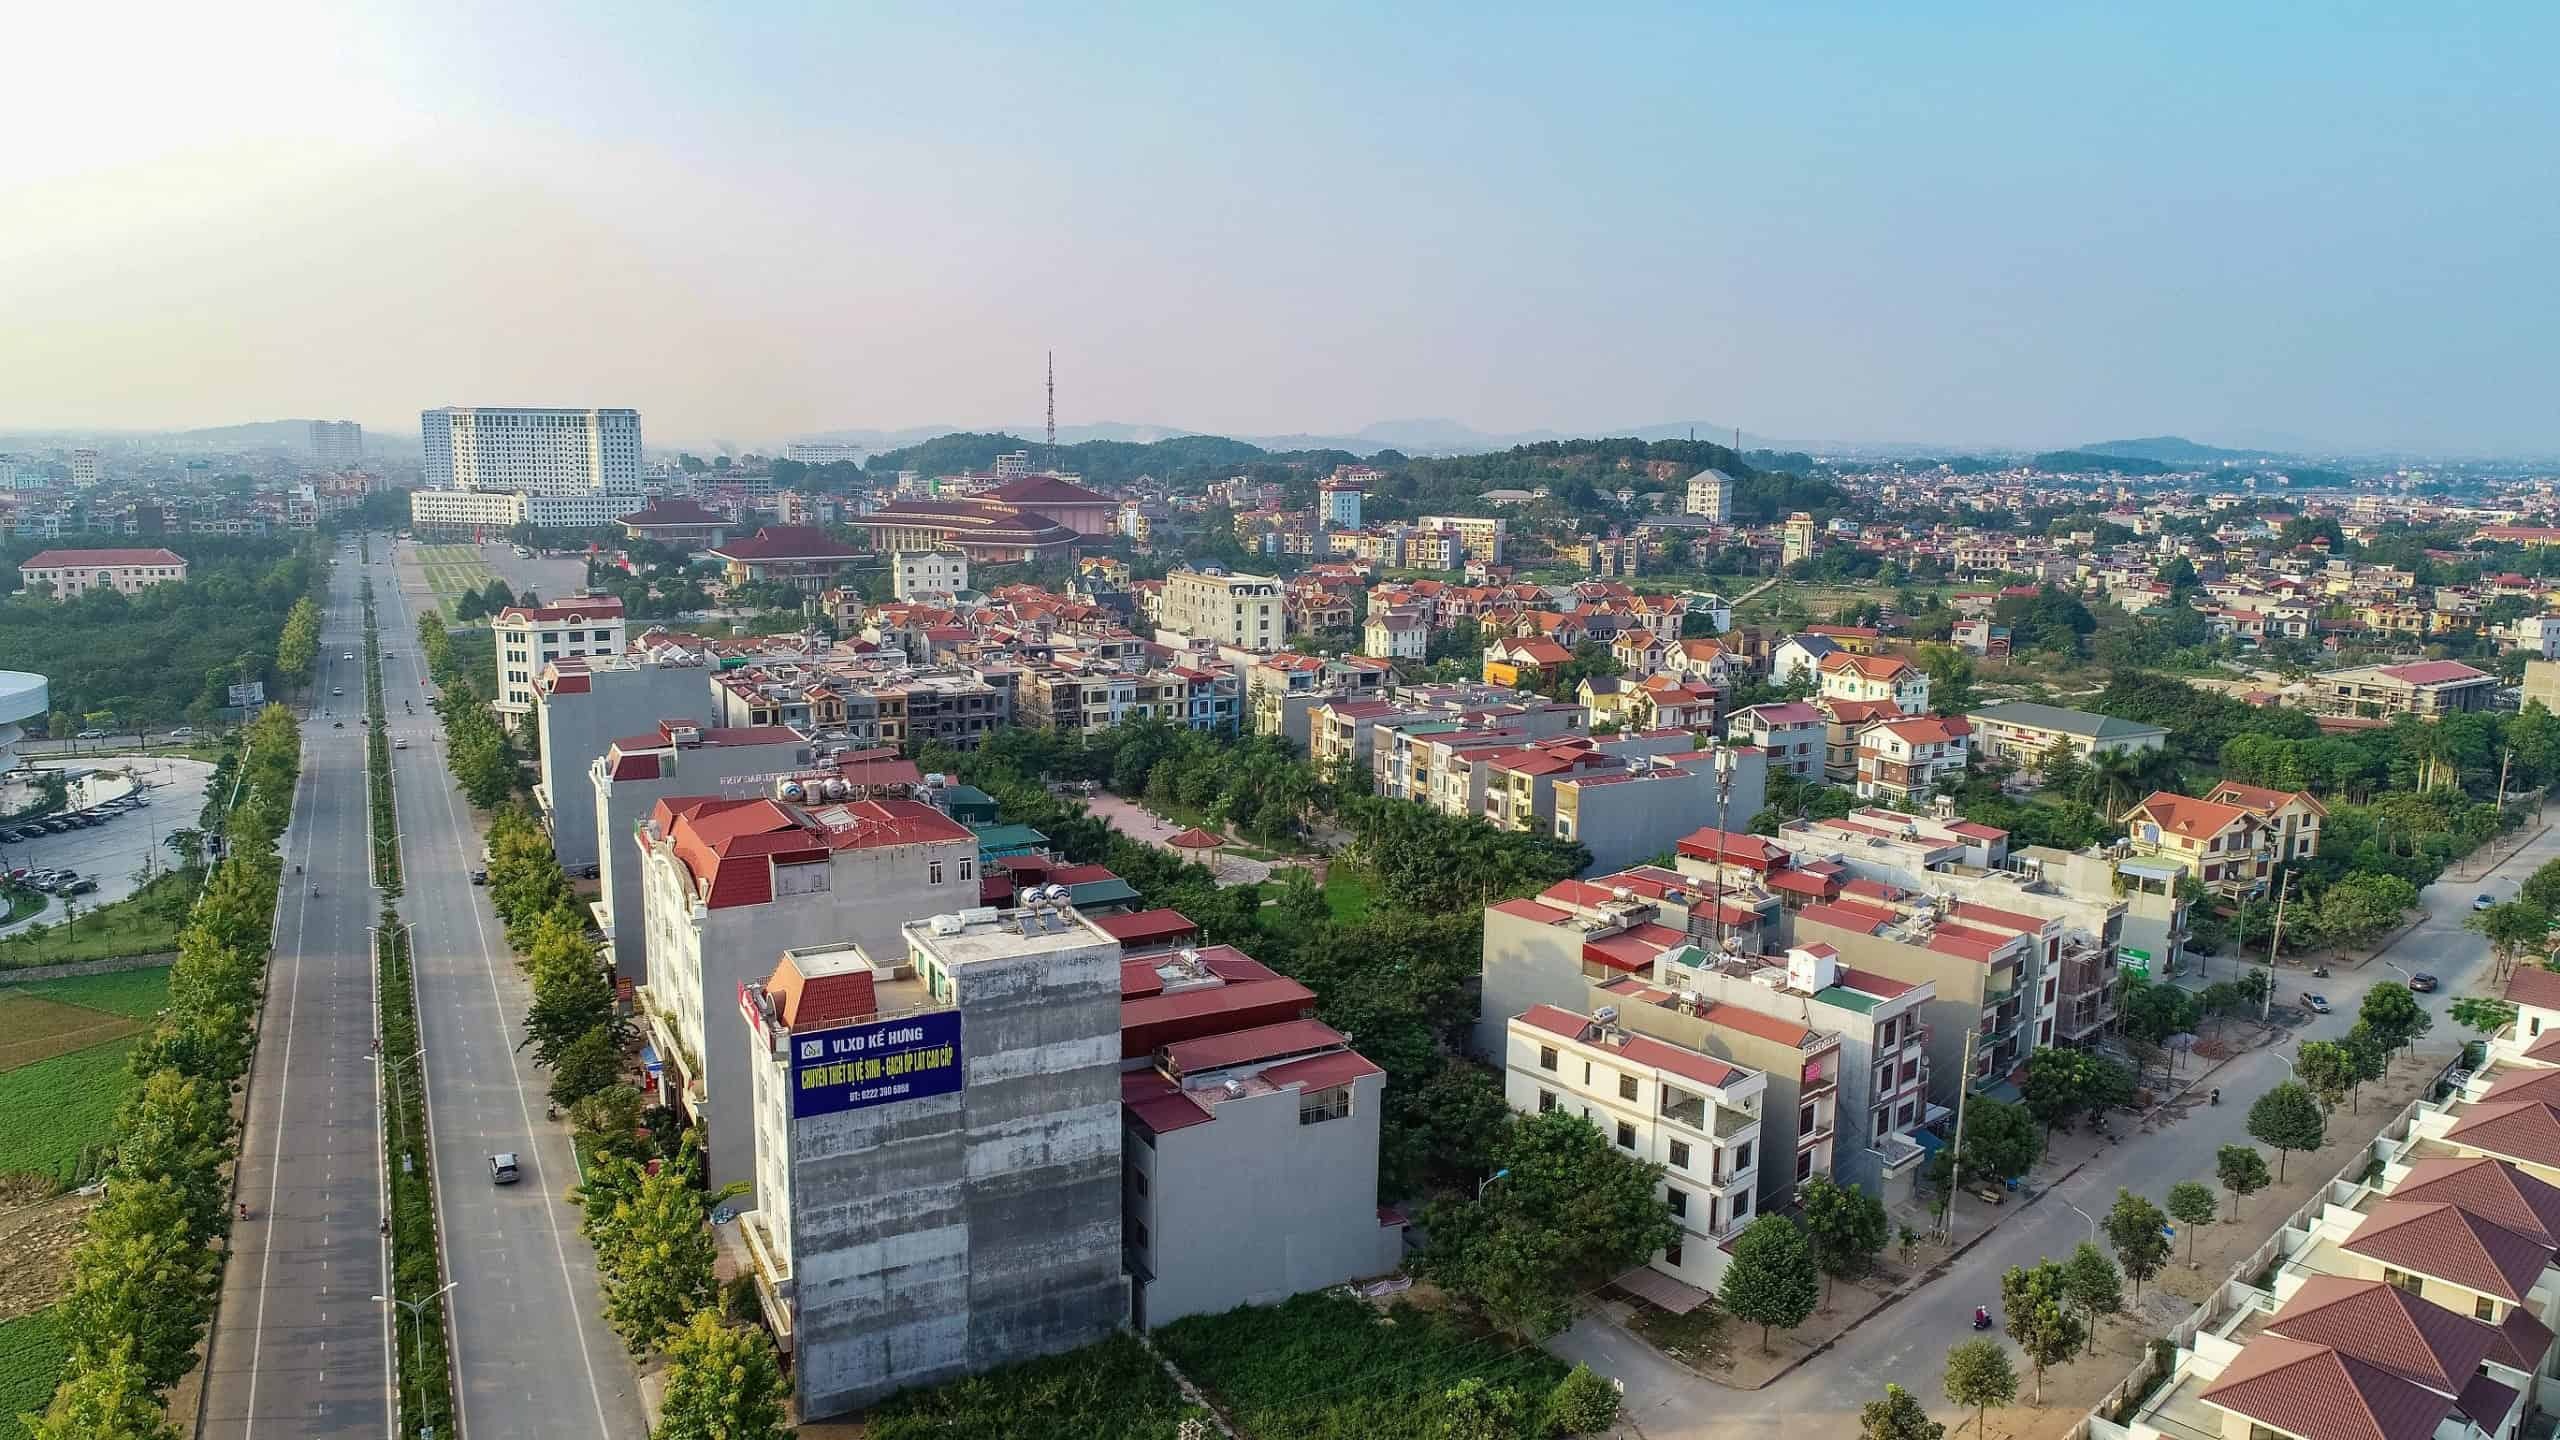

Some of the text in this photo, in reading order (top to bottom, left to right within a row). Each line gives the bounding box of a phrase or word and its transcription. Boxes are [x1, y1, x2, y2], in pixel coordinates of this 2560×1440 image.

[832, 1037, 865, 1054] VLXD
[868, 1028, 885, 1049] KẾ
[888, 1027, 923, 1045] HƯNG
[801, 1065, 828, 1090] CHUYÊN
[829, 1057, 846, 1085] THIẾT
[847, 1063, 855, 1086] BỊ
[855, 1057, 864, 1084] VỆ
[865, 1059, 881, 1080] SINH
[886, 1055, 903, 1080] GẠCH
[904, 1047, 913, 1073] ỐP
[914, 1048, 926, 1072] LÁT
[926, 1049, 939, 1069] CAO
[940, 1040, 953, 1068] CẤP
[861, 1087, 879, 1100] 0222
